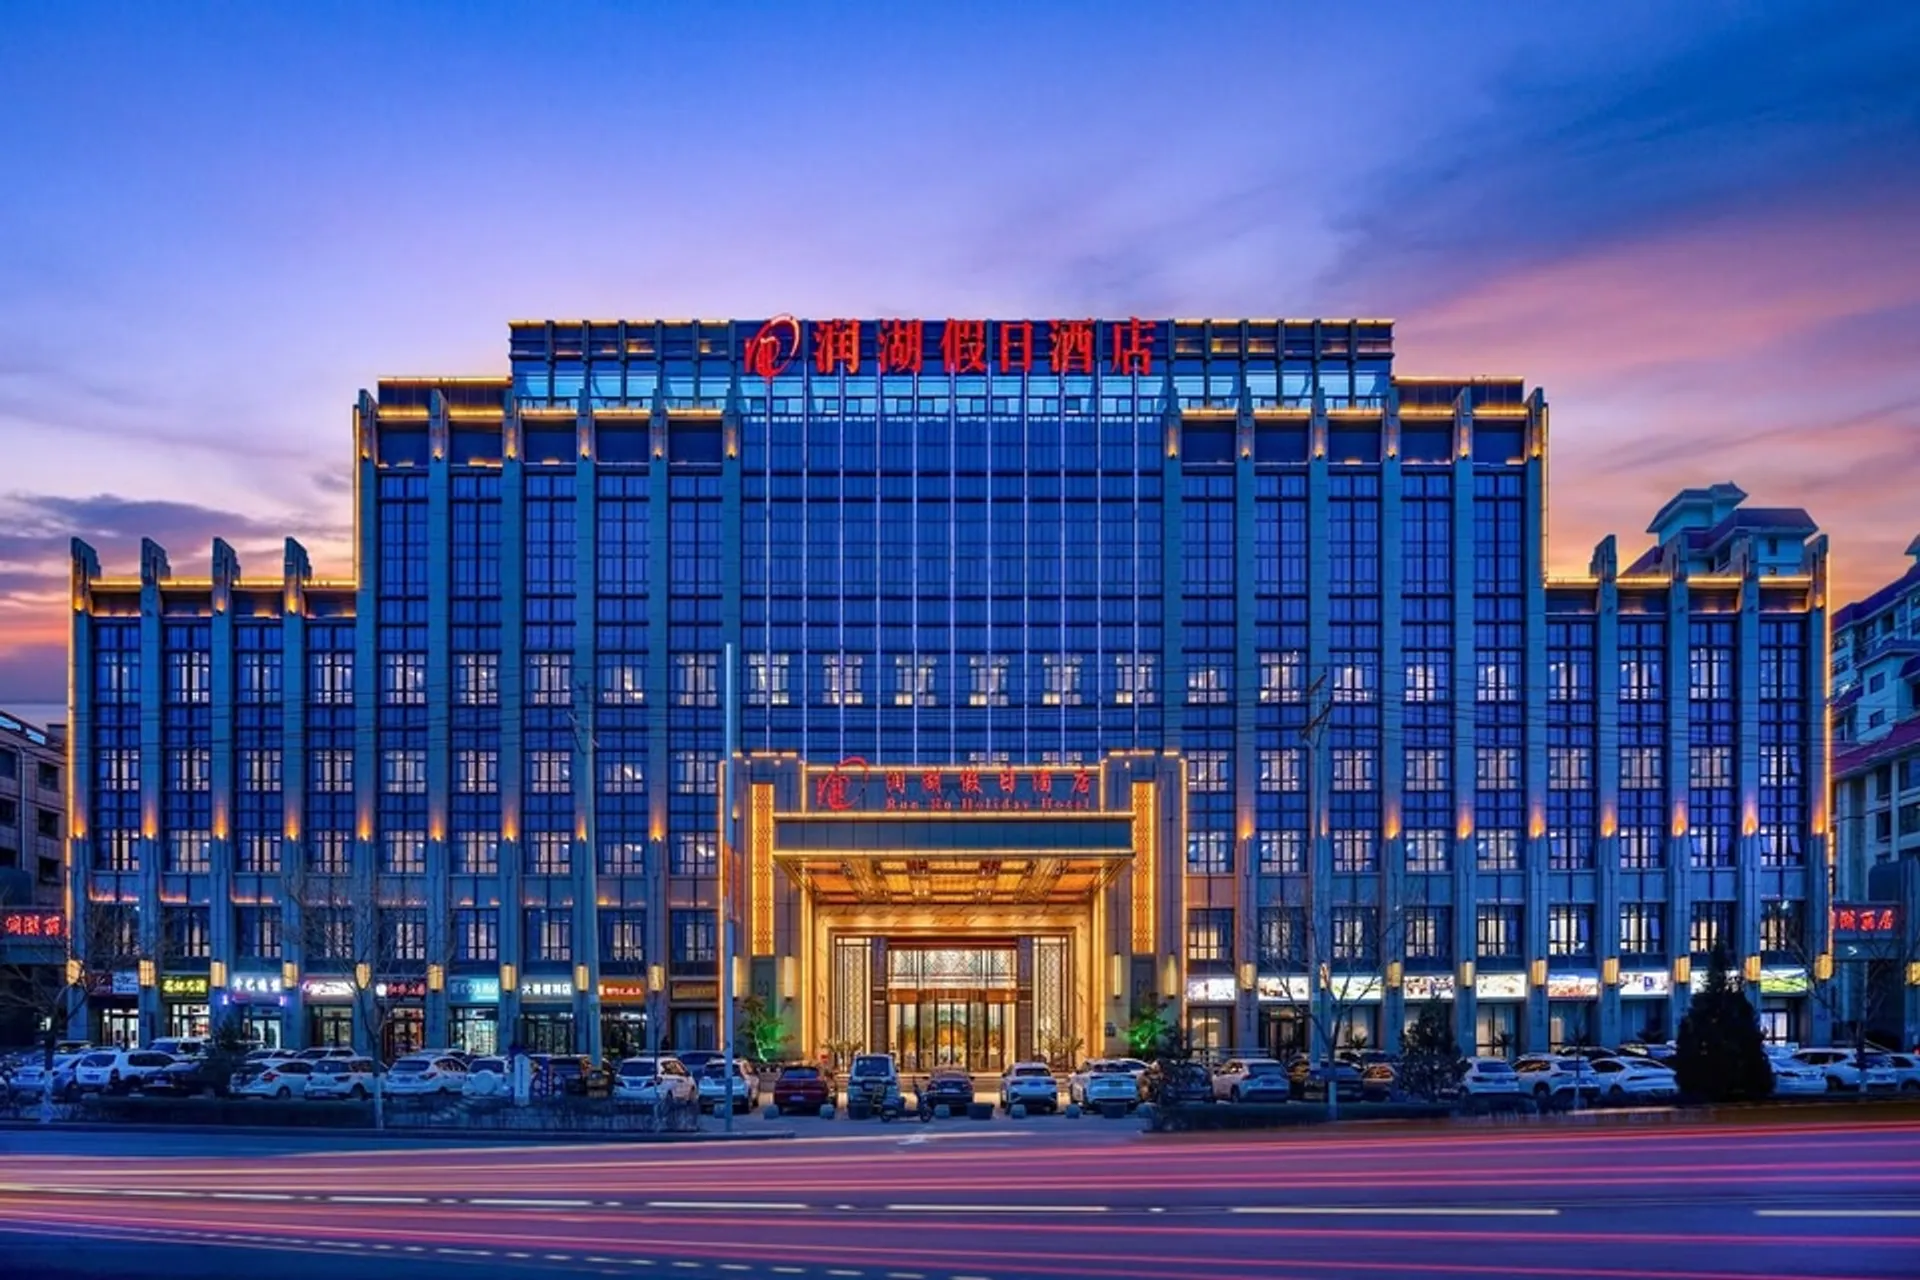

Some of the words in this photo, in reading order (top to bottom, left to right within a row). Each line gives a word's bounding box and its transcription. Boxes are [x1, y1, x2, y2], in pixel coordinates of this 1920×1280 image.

[813, 317, 1156, 375] 润湖假日酒店
[886, 766, 1091, 794] 润湖假日酒店
